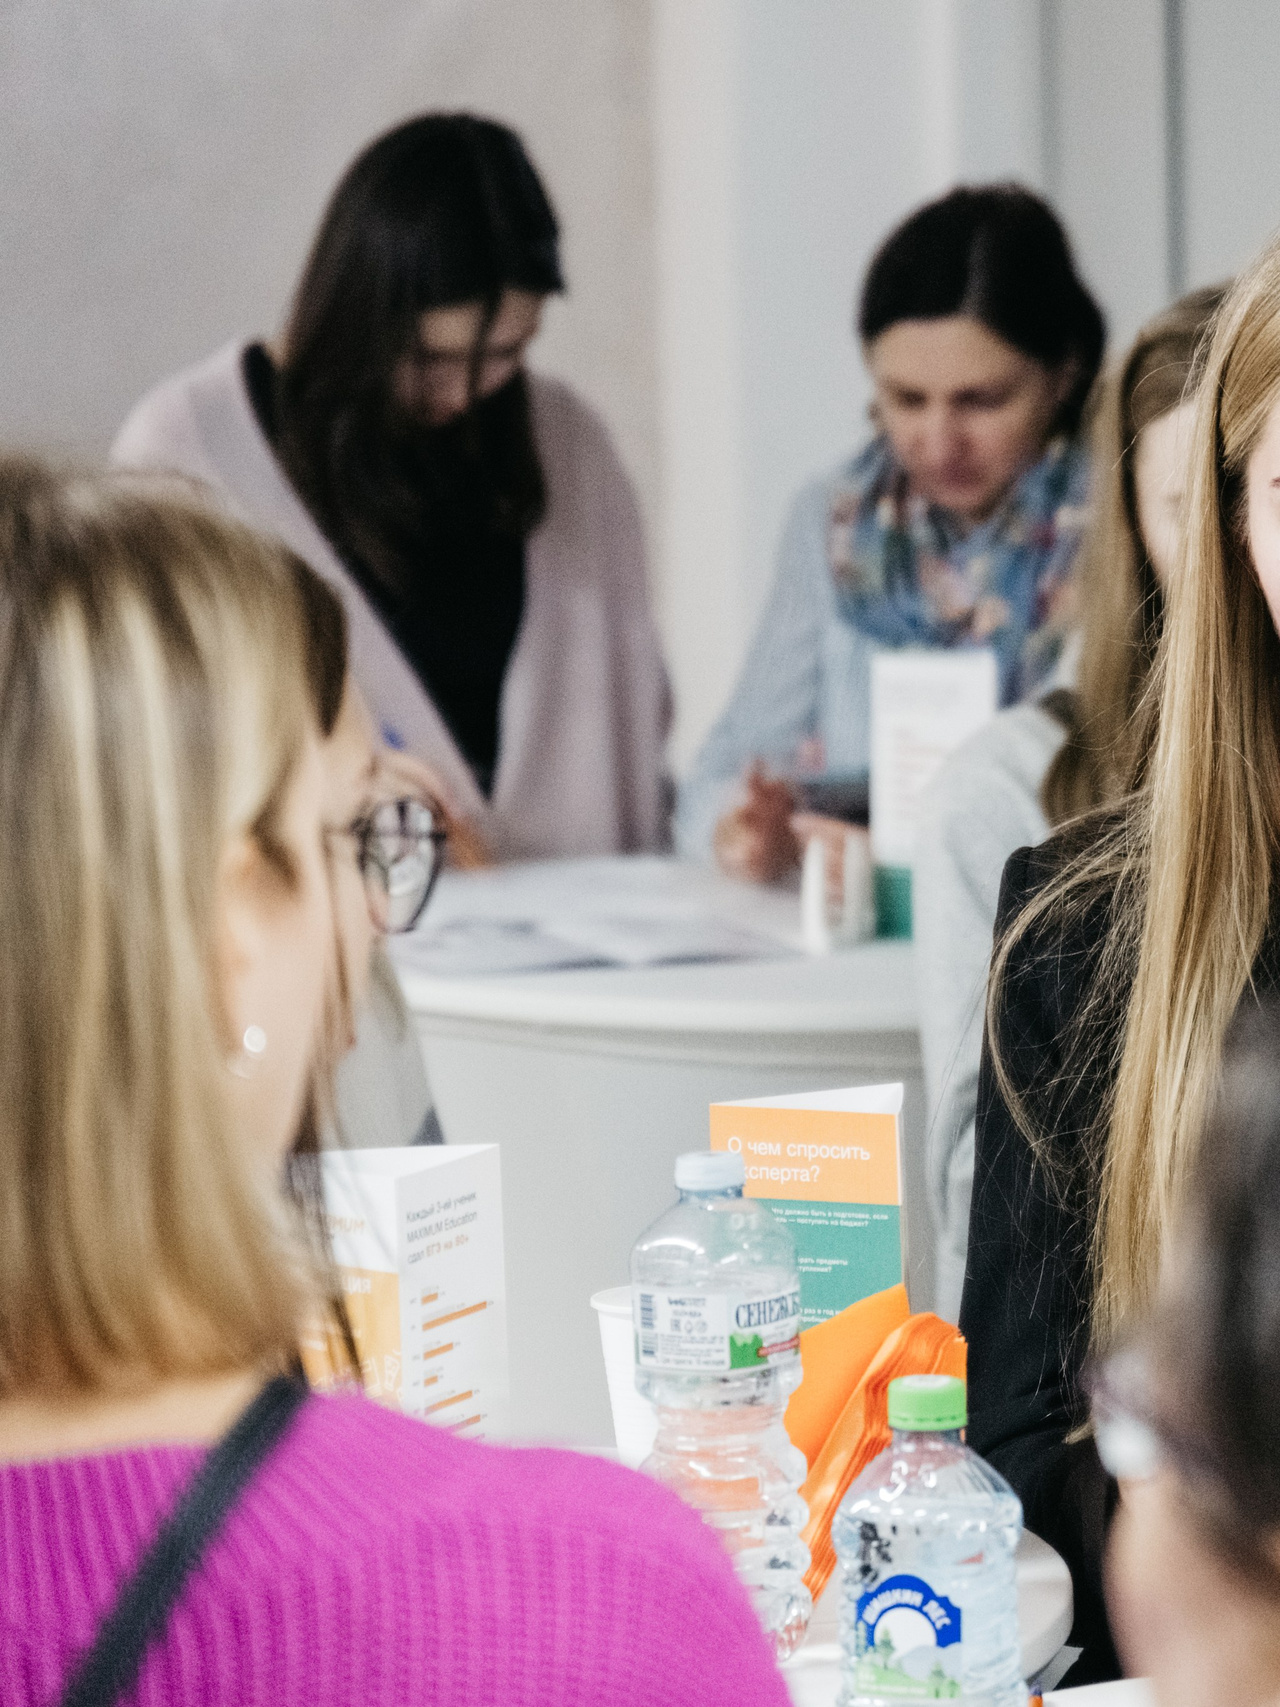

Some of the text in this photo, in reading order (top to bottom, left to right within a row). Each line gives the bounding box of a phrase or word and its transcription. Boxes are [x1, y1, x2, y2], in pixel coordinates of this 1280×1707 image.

[727, 1136, 871, 1162] О чем спросить
[744, 1164, 820, 1185] ксперта?
[406, 1211, 478, 1243] MAXIMUM Education
[798, 1265, 832, 1273] тупления?
